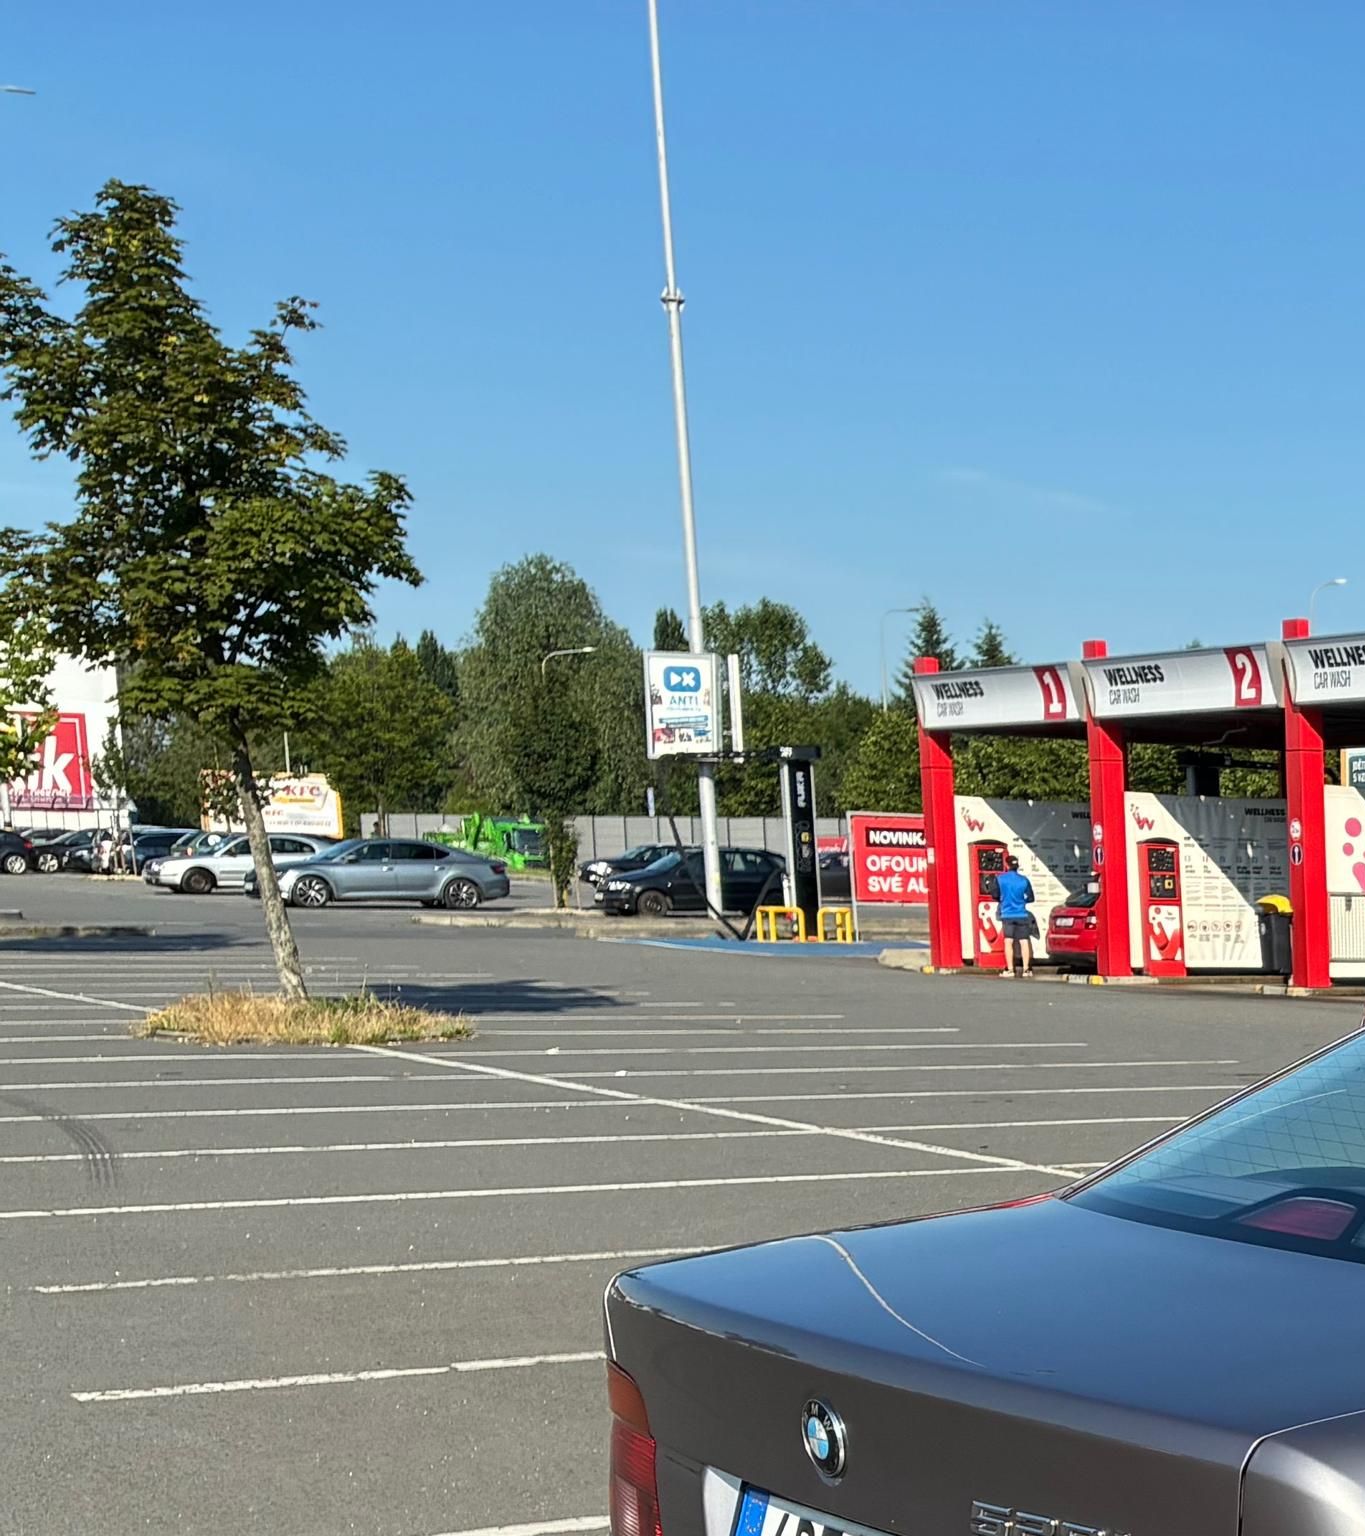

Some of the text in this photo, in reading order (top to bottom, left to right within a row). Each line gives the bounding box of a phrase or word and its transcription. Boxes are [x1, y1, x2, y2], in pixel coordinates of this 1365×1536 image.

[1103, 664, 1165, 687] WELLNESS
[1235, 652, 1257, 700] 2
[1313, 669, 1351, 690] CAR WASH
[669, 695, 698, 705] ANTI
[931, 681, 985, 700] WELLNESS
[1042, 671, 1062, 713] 1
[1109, 687, 1140, 705] CAR WASH
[285, 785, 321, 797] KFC
[869, 830, 926, 846] NOVINK
[867, 873, 903, 893] SVÉ
